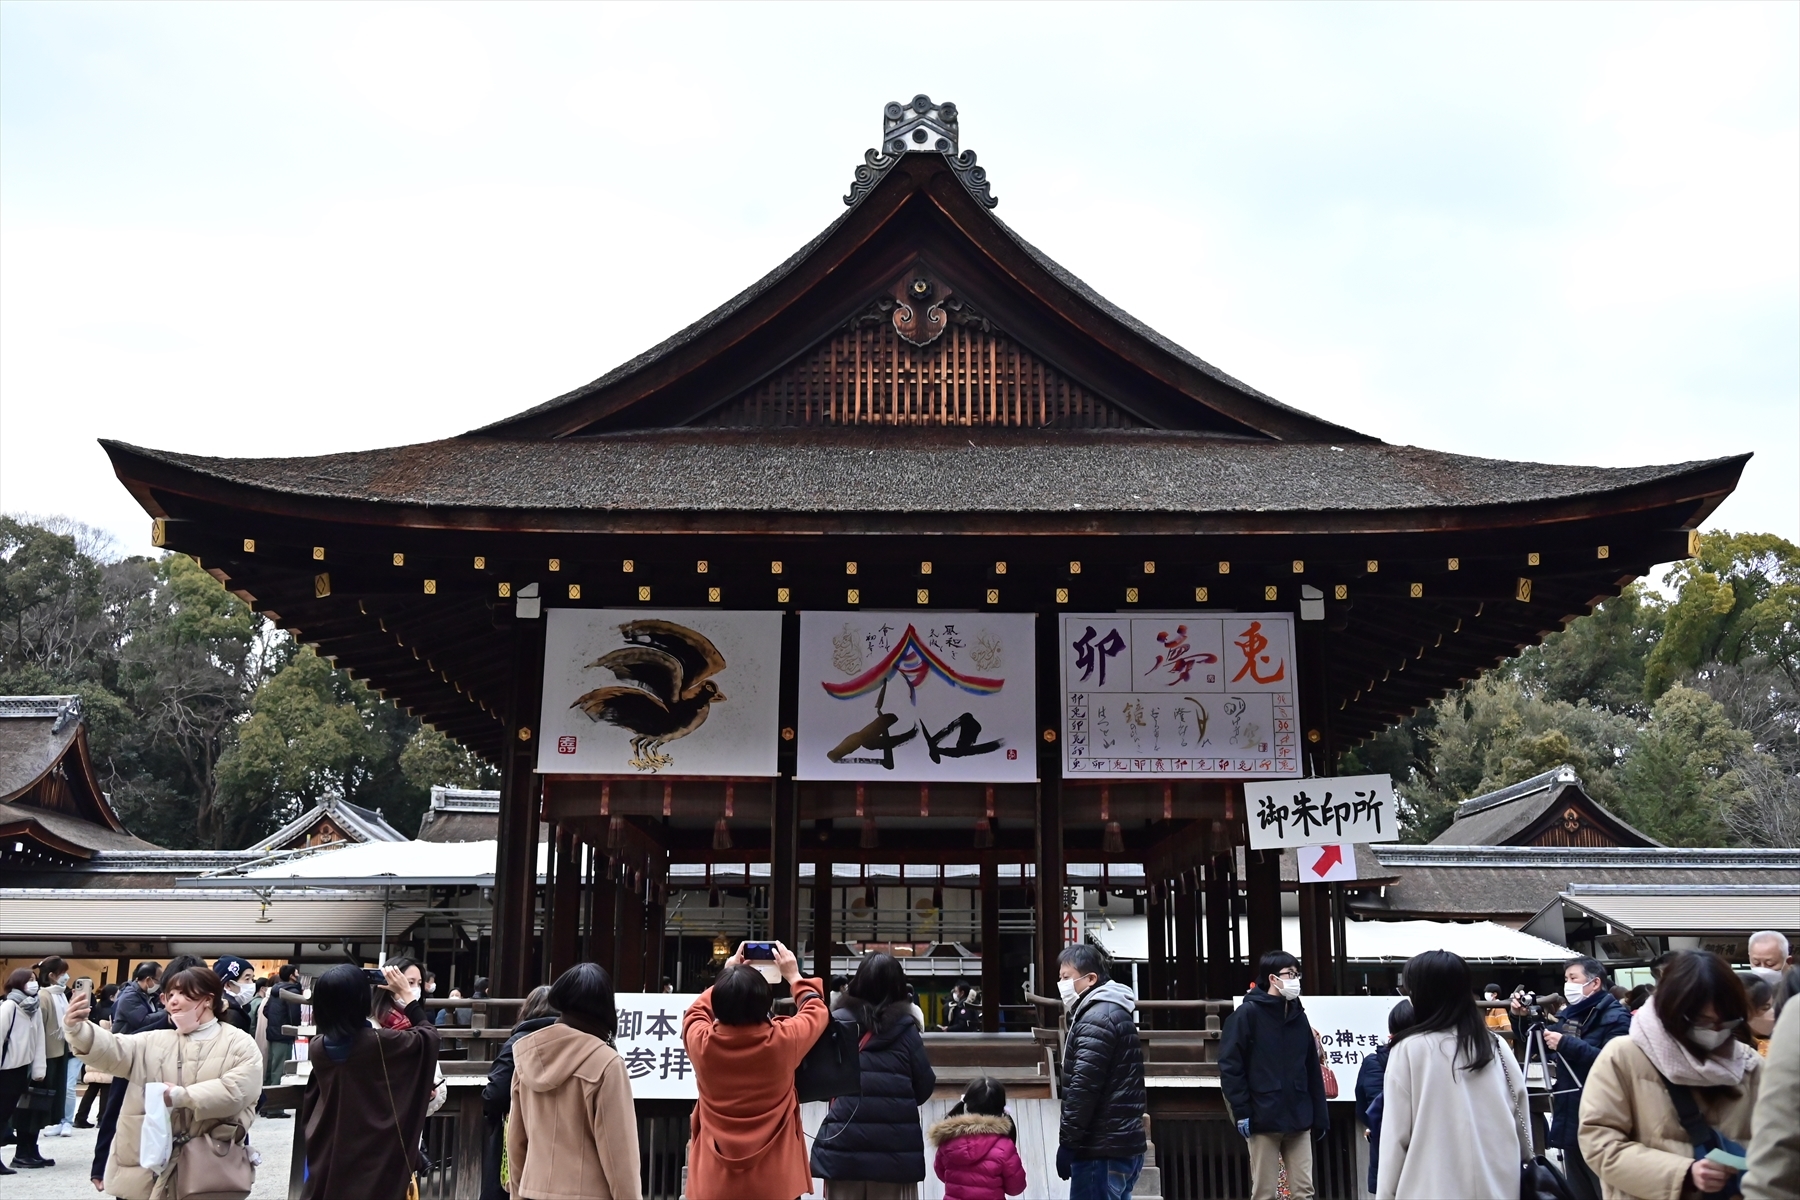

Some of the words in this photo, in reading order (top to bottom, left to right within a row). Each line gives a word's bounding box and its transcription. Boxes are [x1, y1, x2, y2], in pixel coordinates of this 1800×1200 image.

[1073, 626, 1126, 687] 卯
[1256, 790, 1384, 839] 御朱印所
[617, 1008, 686, 1041] 御本
